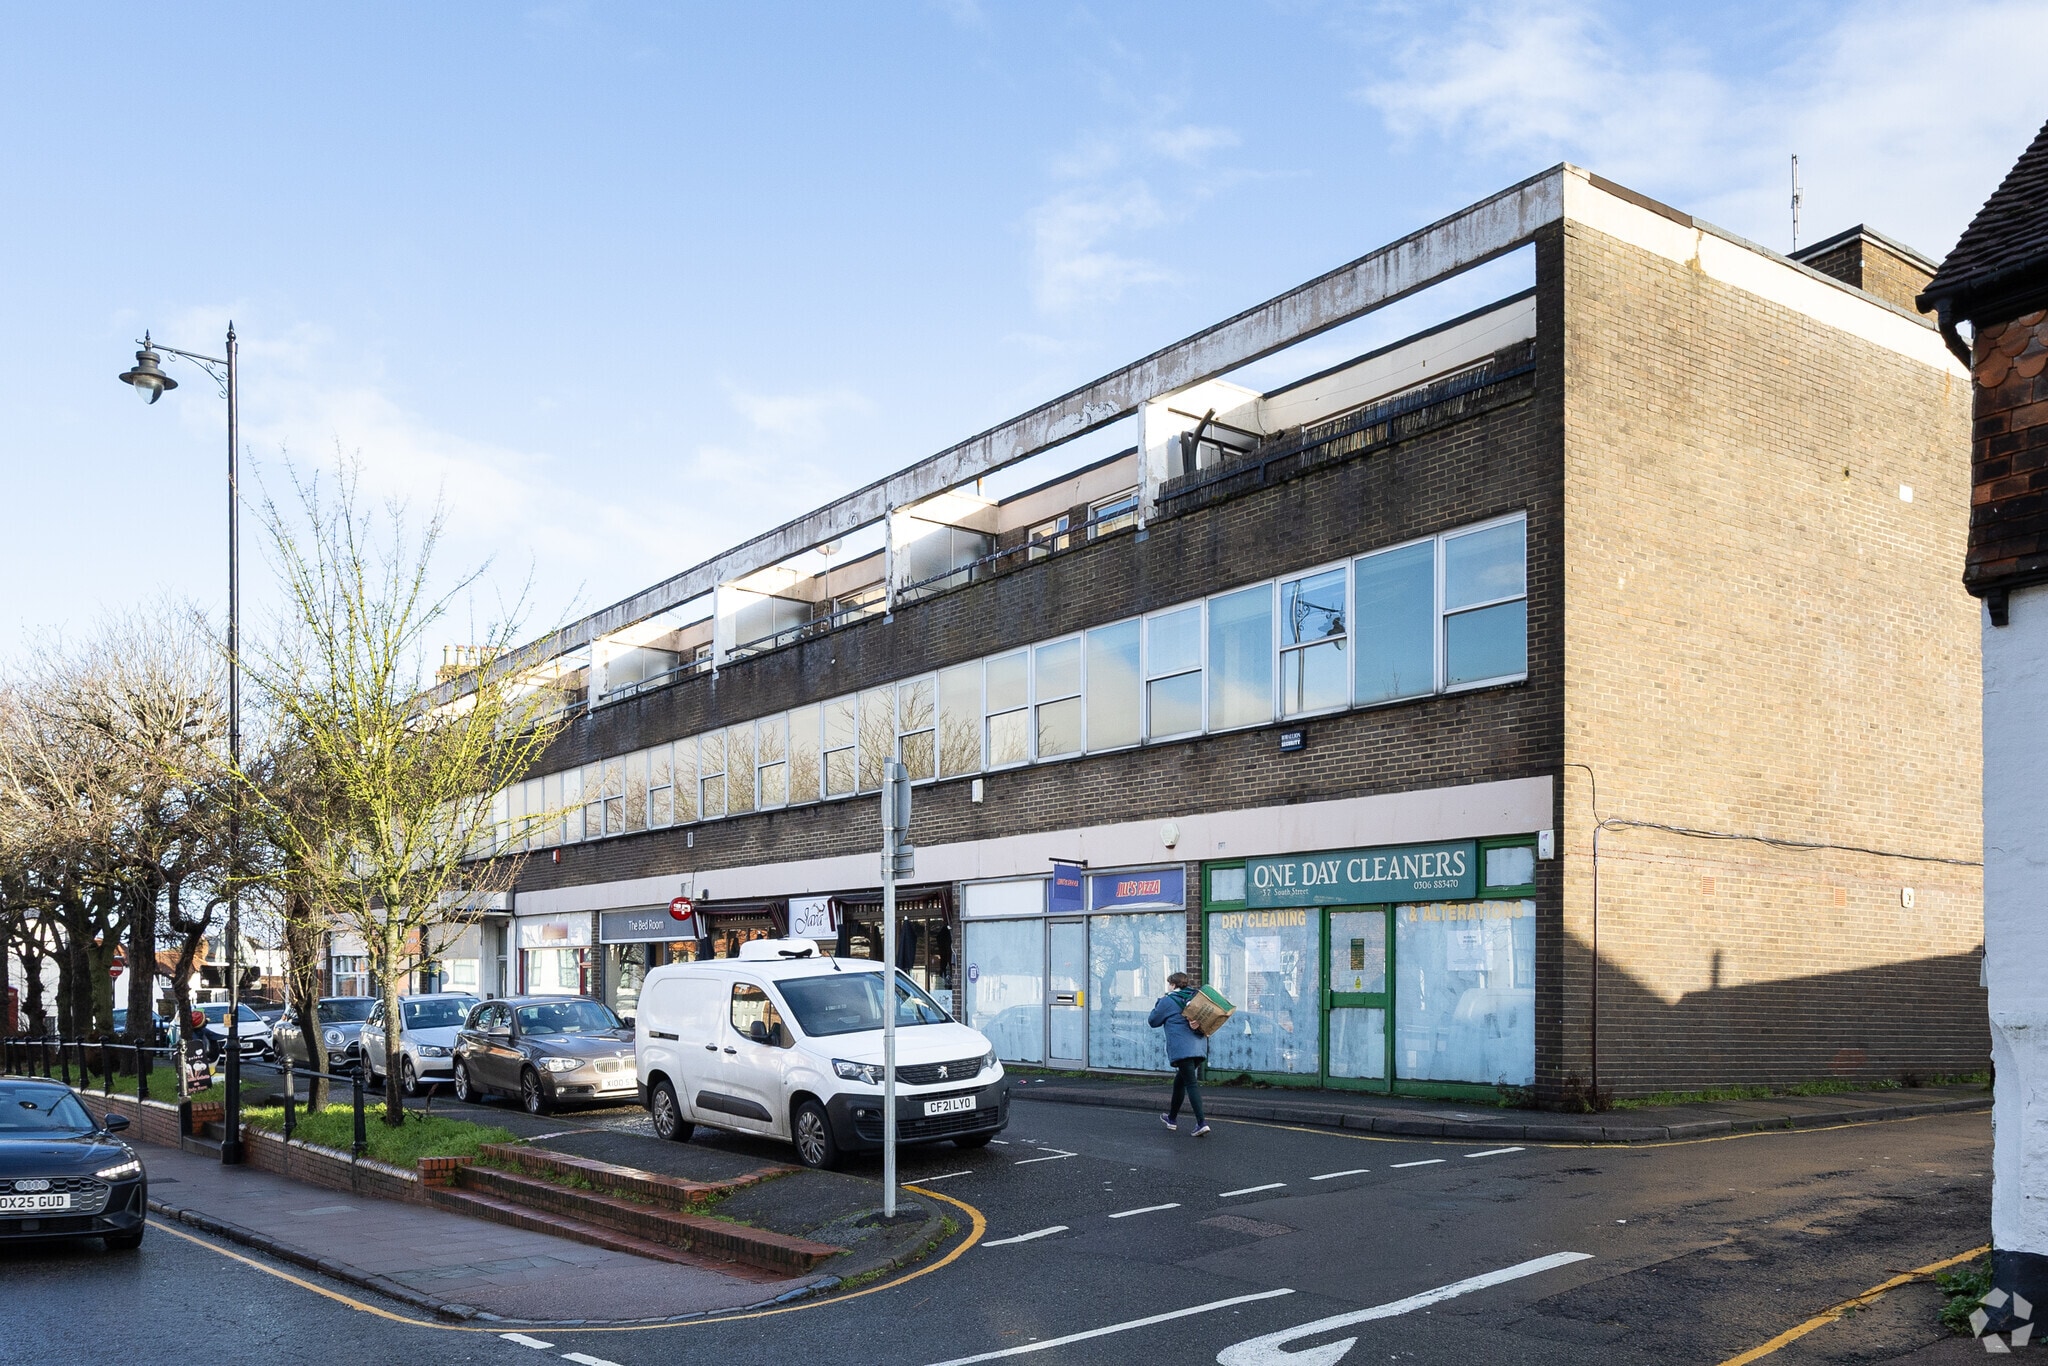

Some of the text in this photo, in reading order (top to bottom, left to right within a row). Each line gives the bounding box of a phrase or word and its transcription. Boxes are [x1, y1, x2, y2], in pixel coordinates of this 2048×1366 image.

[1253, 850, 1466, 889] ONE DAY CLEANERS
[1115, 879, 1161, 898] JILL'S PIZZA
[1274, 888, 1290, 896] South
[1291, 888, 1309, 897] Street
[1413, 880, 1432, 890] 0306
[1222, 910, 1306, 929] DRY CLEANING
[1409, 901, 1523, 922] & ALTERATIONS
[628, 919, 665, 931] The Bed Room
[795, 907, 824, 935] Java
[930, 1097, 971, 1113] CF21 LYO
[0, 1196, 64, 1209] OX25 GUD
